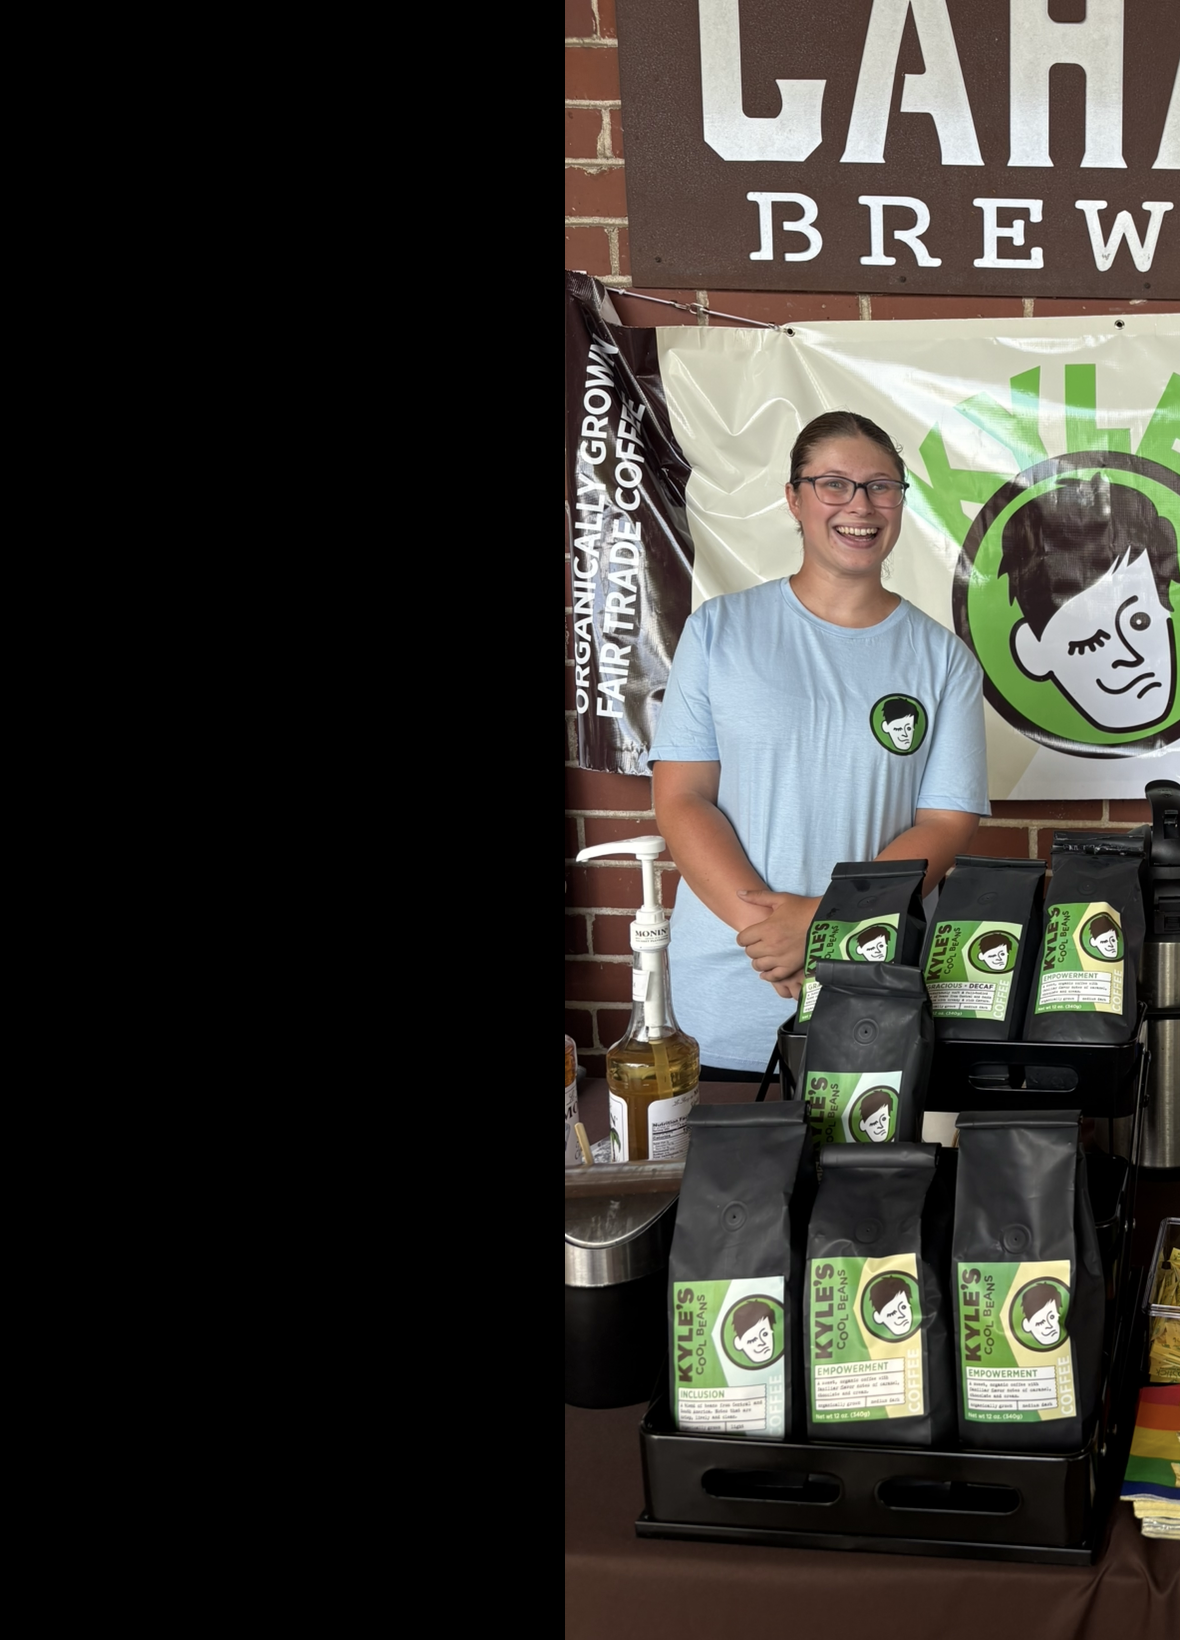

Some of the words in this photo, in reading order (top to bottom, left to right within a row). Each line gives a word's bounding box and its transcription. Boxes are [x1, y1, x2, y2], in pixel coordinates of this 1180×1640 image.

[580, 333, 619, 466] GROWN
[614, 392, 646, 511] COFFEE
[573, 470, 606, 714] ORGANICALLY
[603, 519, 641, 635] TRADE
[597, 644, 633, 719] FAIR
[635, 928, 667, 938] MONIN
[826, 925, 840, 948] BEANS
[949, 927, 961, 952] BEANS
[1043, 907, 1061, 971] KYLE'S
[1060, 910, 1071, 937] BEANS
[926, 923, 952, 981] KYLE'S
[943, 953, 957, 975] COOL
[1057, 939, 1068, 963] COOL
[1044, 972, 1099, 982] EMPOWERMENT
[1111, 969, 1122, 1012] COFFEE
[993, 979, 1010, 1019] COFFEE
[827, 1083, 840, 1119] BEANS
[824, 1121, 837, 1143] OOL
[838, 1270, 848, 1310] BEANS
[983, 1275, 995, 1317] BEANS
[696, 1294, 708, 1336] BEANS
[813, 1264, 834, 1359] KYLE'S
[961, 1268, 981, 1362] KYLE'S
[676, 1287, 695, 1383] KYLE'S
[837, 1314, 848, 1350] COOL
[984, 1321, 995, 1355] COOL
[695, 1339, 707, 1376] COOL
[817, 1361, 889, 1376] EMPOWERMENT
[968, 1368, 1038, 1378] EMPOWERMENT
[680, 1389, 725, 1399] INCLUSION
[907, 1349, 920, 1413] COFFEE
[1058, 1355, 1073, 1415] COFFEE
[768, 1373, 783, 1436] COFFEE
